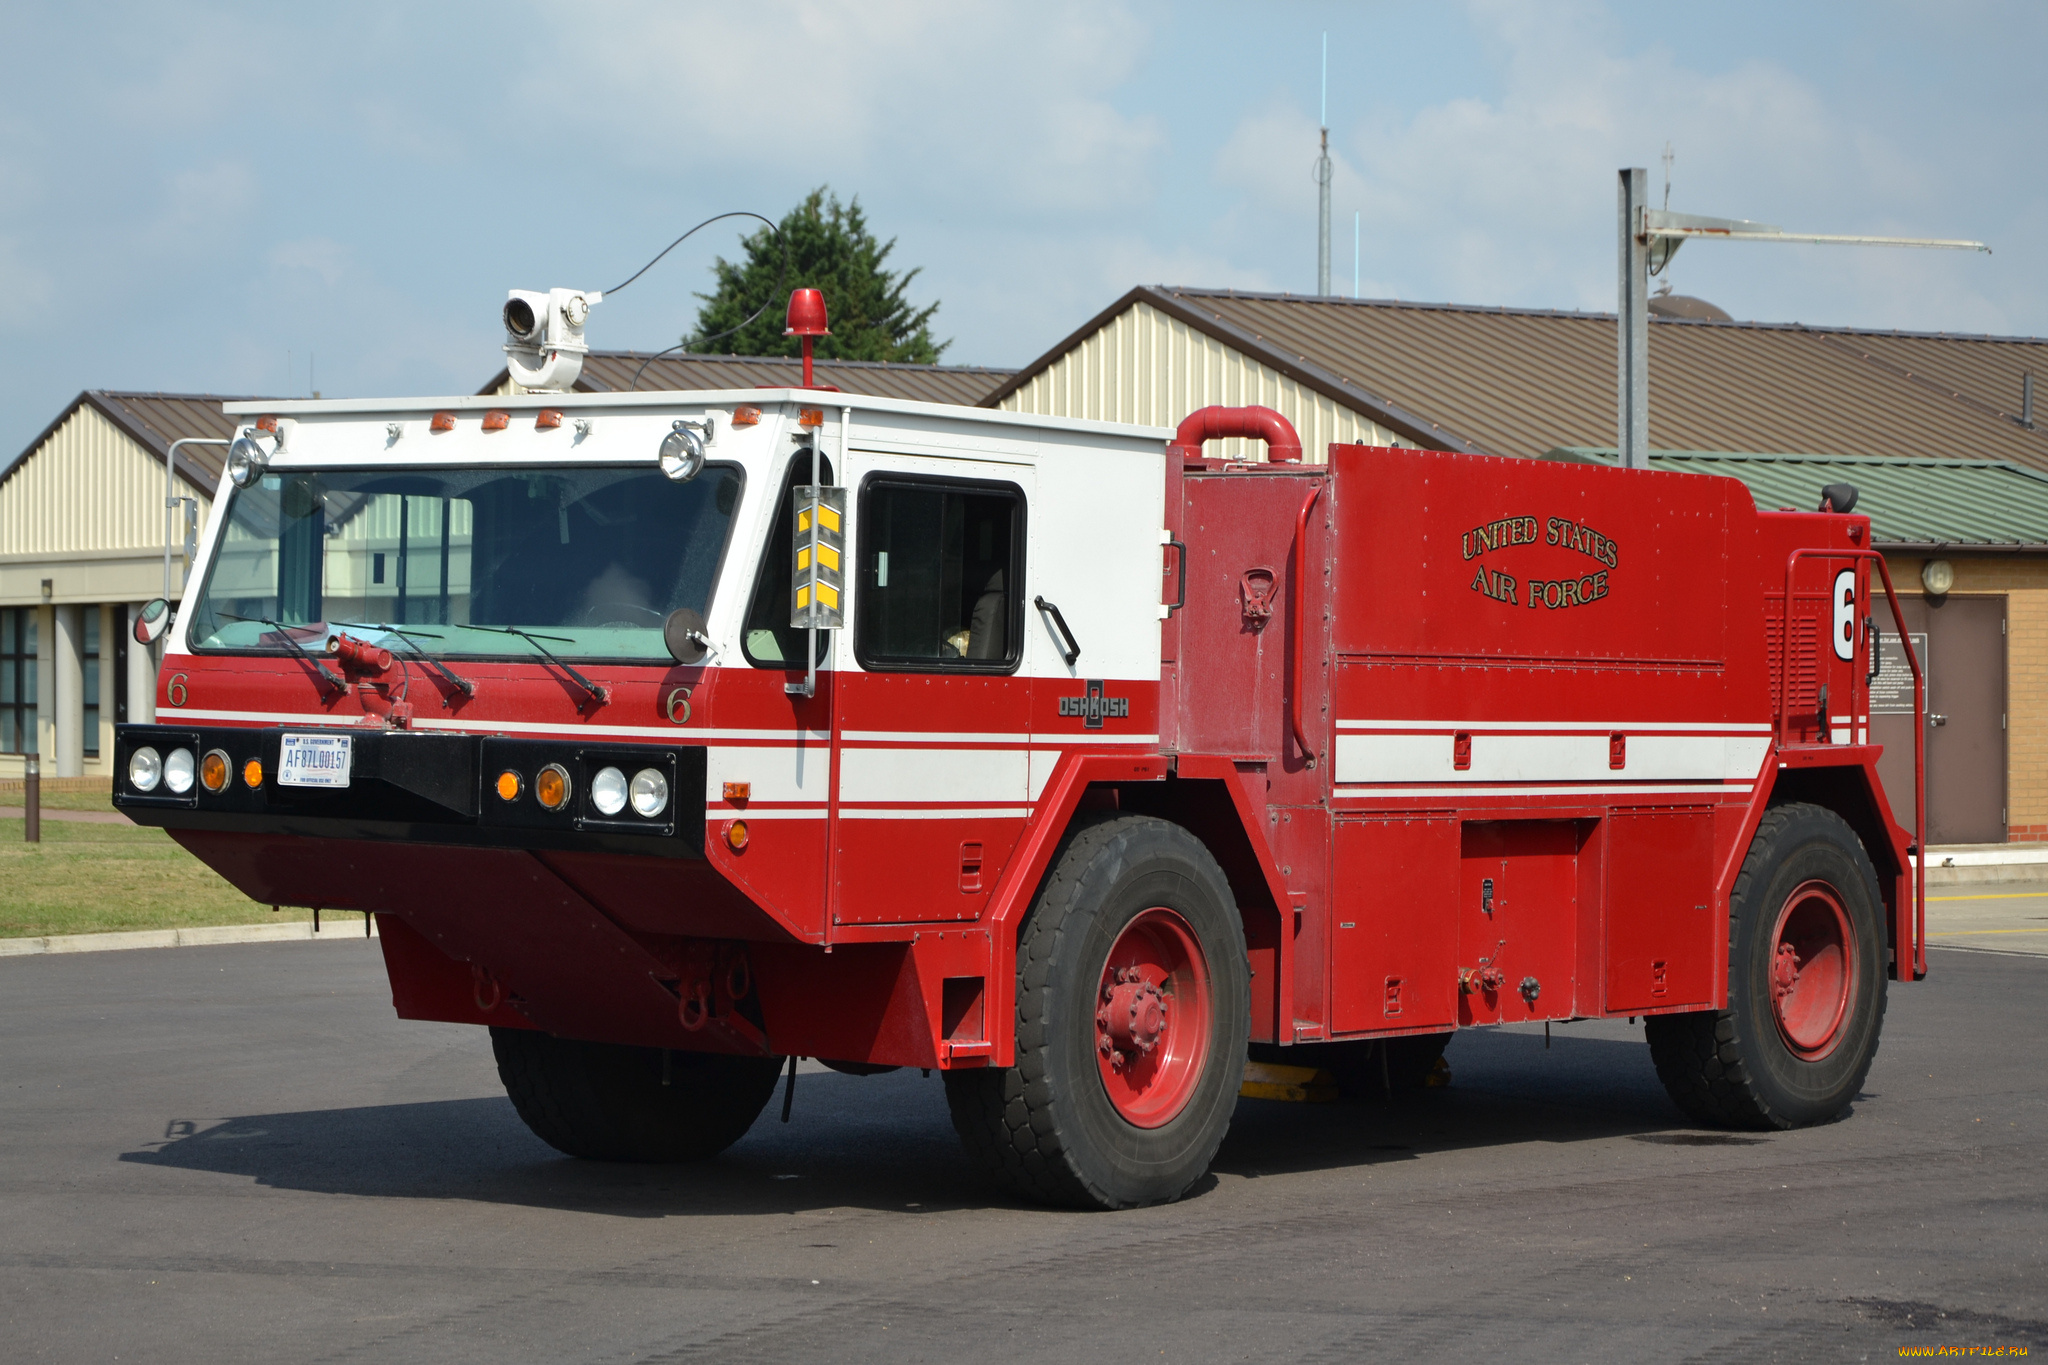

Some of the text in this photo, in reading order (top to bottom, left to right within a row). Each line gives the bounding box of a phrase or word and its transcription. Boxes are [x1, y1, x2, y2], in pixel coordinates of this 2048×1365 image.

[1462, 516, 1618, 569] UNITED STATES
[1471, 565, 1609, 609] AIR FORCE
[1833, 567, 1864, 662] 6
[167, 672, 188, 707] 6
[666, 687, 692, 724] 6
[1059, 697, 1129, 717] OSHKOSH
[286, 749, 346, 769] AF87L00157
